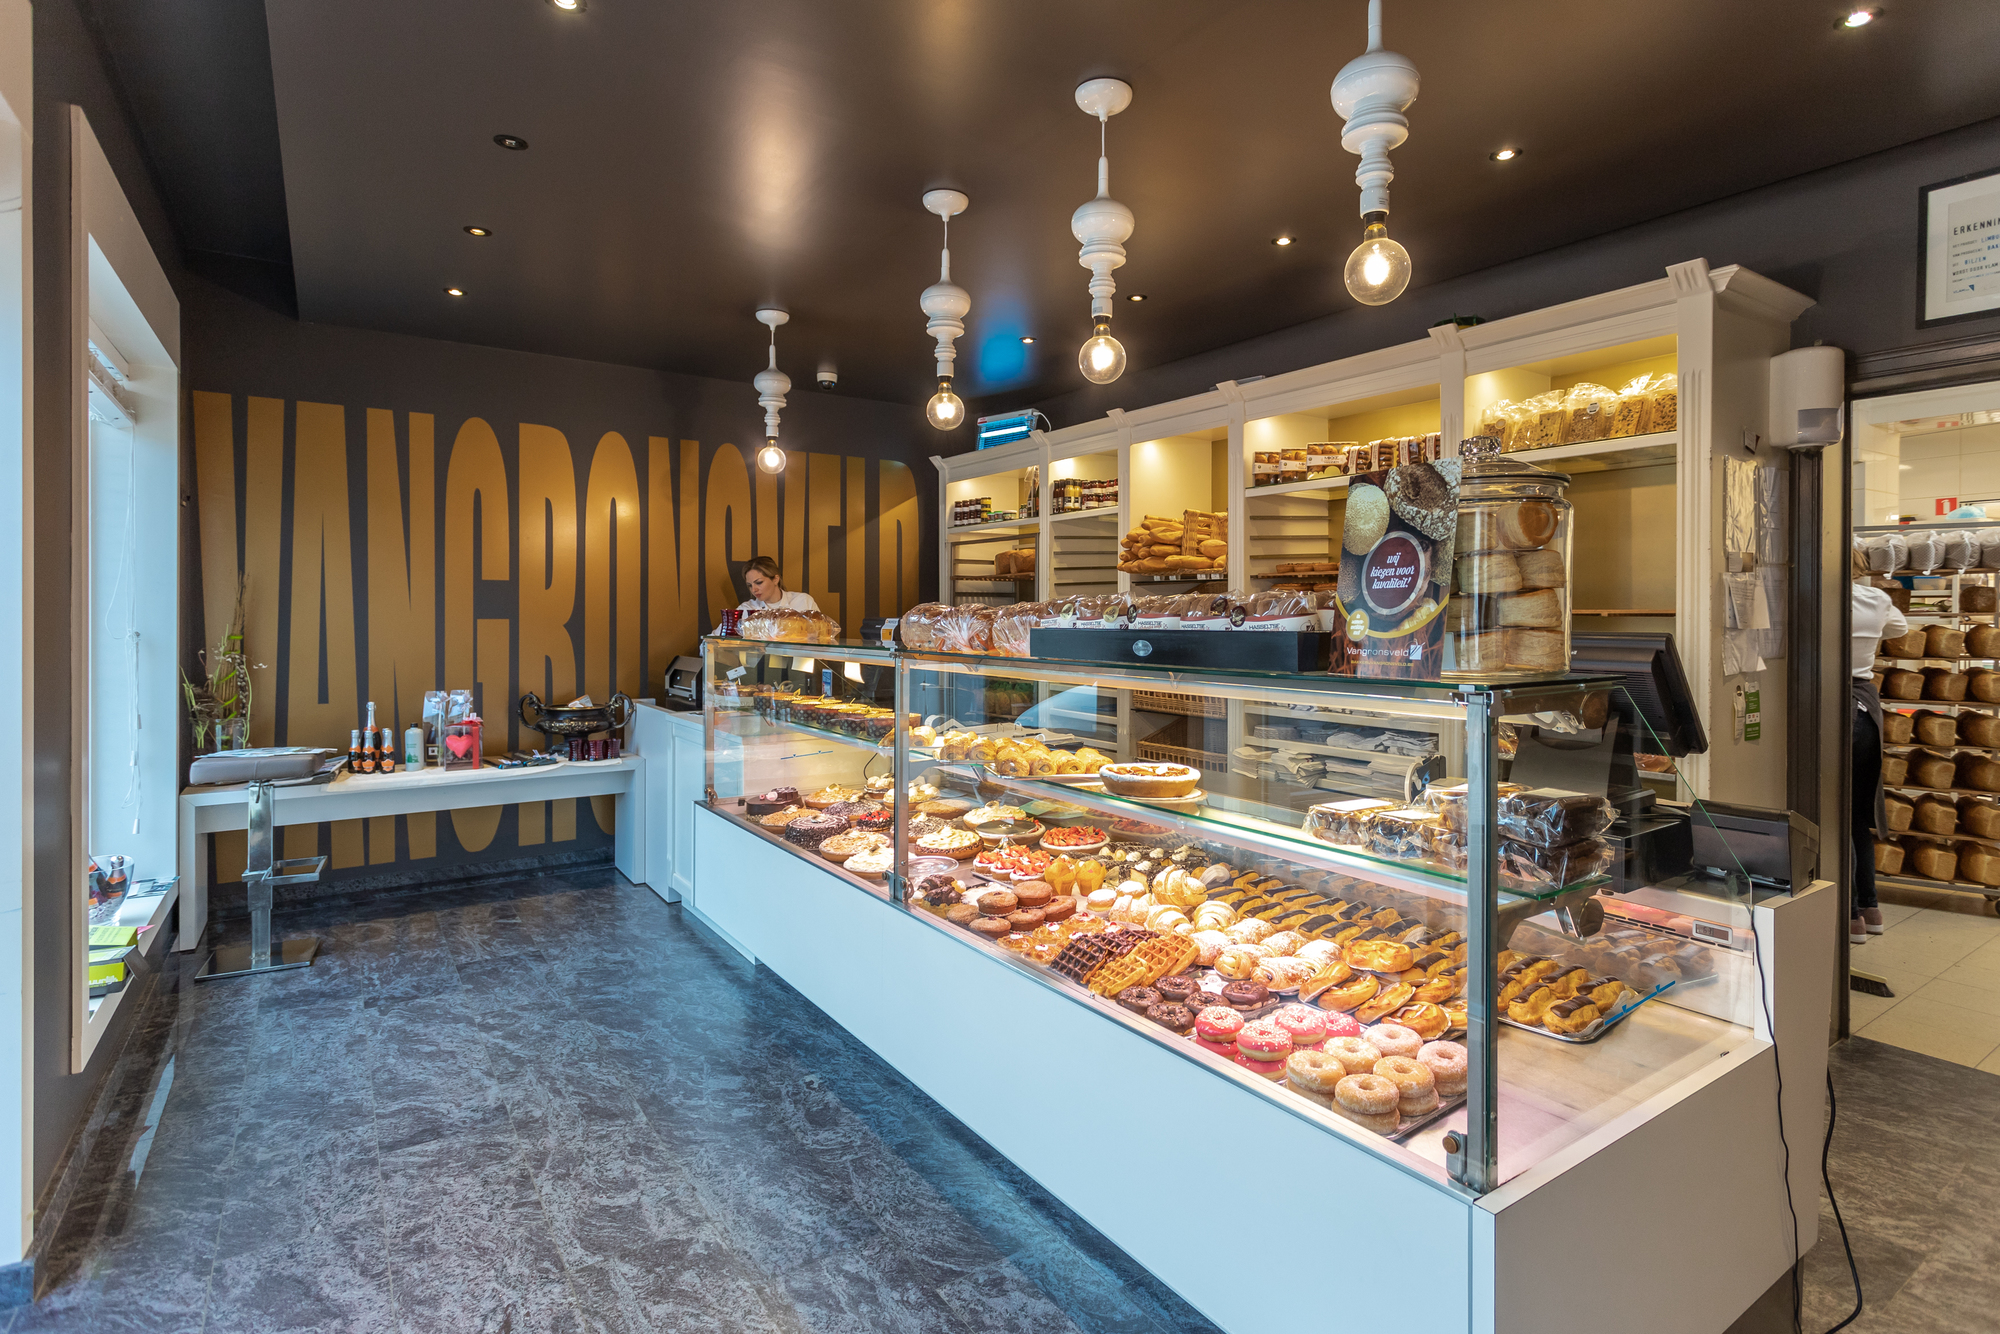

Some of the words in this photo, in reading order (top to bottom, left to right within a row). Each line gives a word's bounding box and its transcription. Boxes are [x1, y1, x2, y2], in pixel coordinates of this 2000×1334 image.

[1370, 566, 1395, 579] kiezen
[1395, 565, 1415, 576] voor
[1372, 577, 1412, 589] kwaliteit!
[1346, 646, 1410, 657] Vangronsveld
